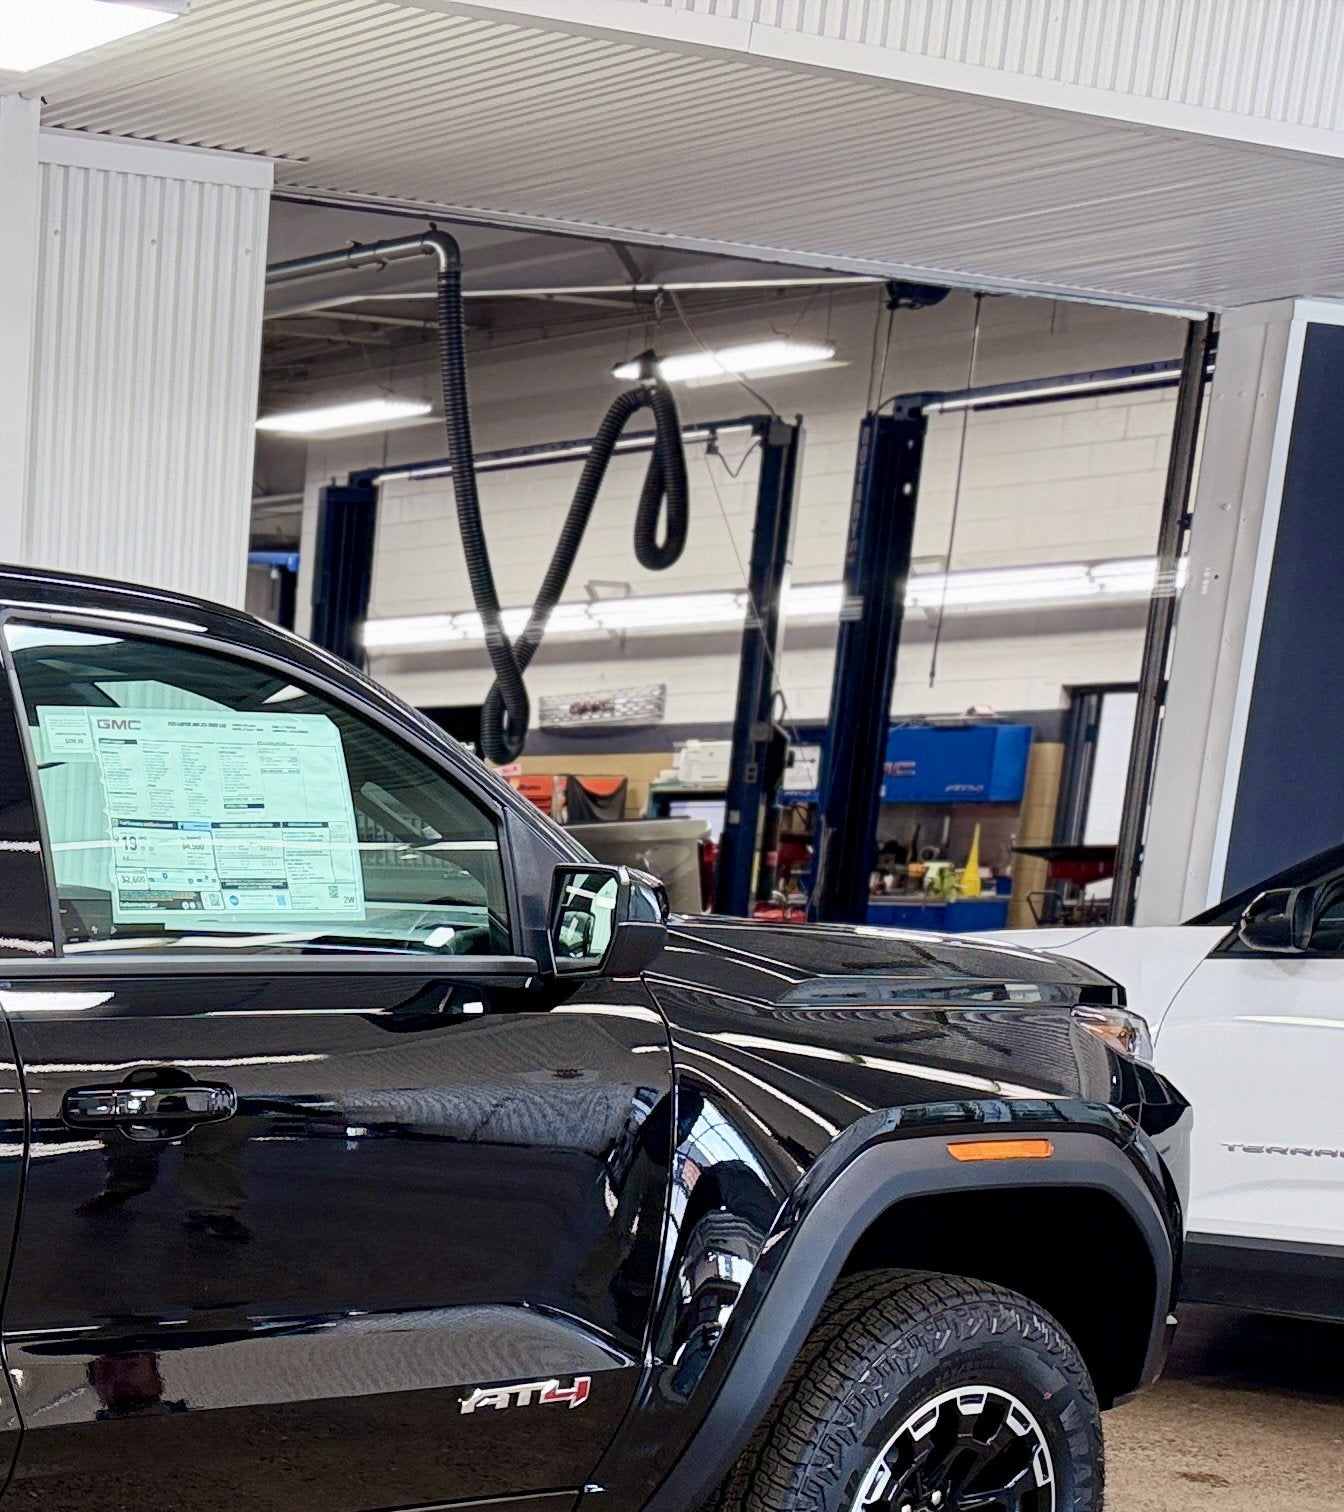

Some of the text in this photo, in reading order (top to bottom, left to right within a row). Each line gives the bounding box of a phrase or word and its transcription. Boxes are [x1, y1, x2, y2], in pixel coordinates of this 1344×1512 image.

[97, 719, 142, 731] GMC
[122, 836, 138, 851] 19
[458, 1376, 592, 1415] AT4
